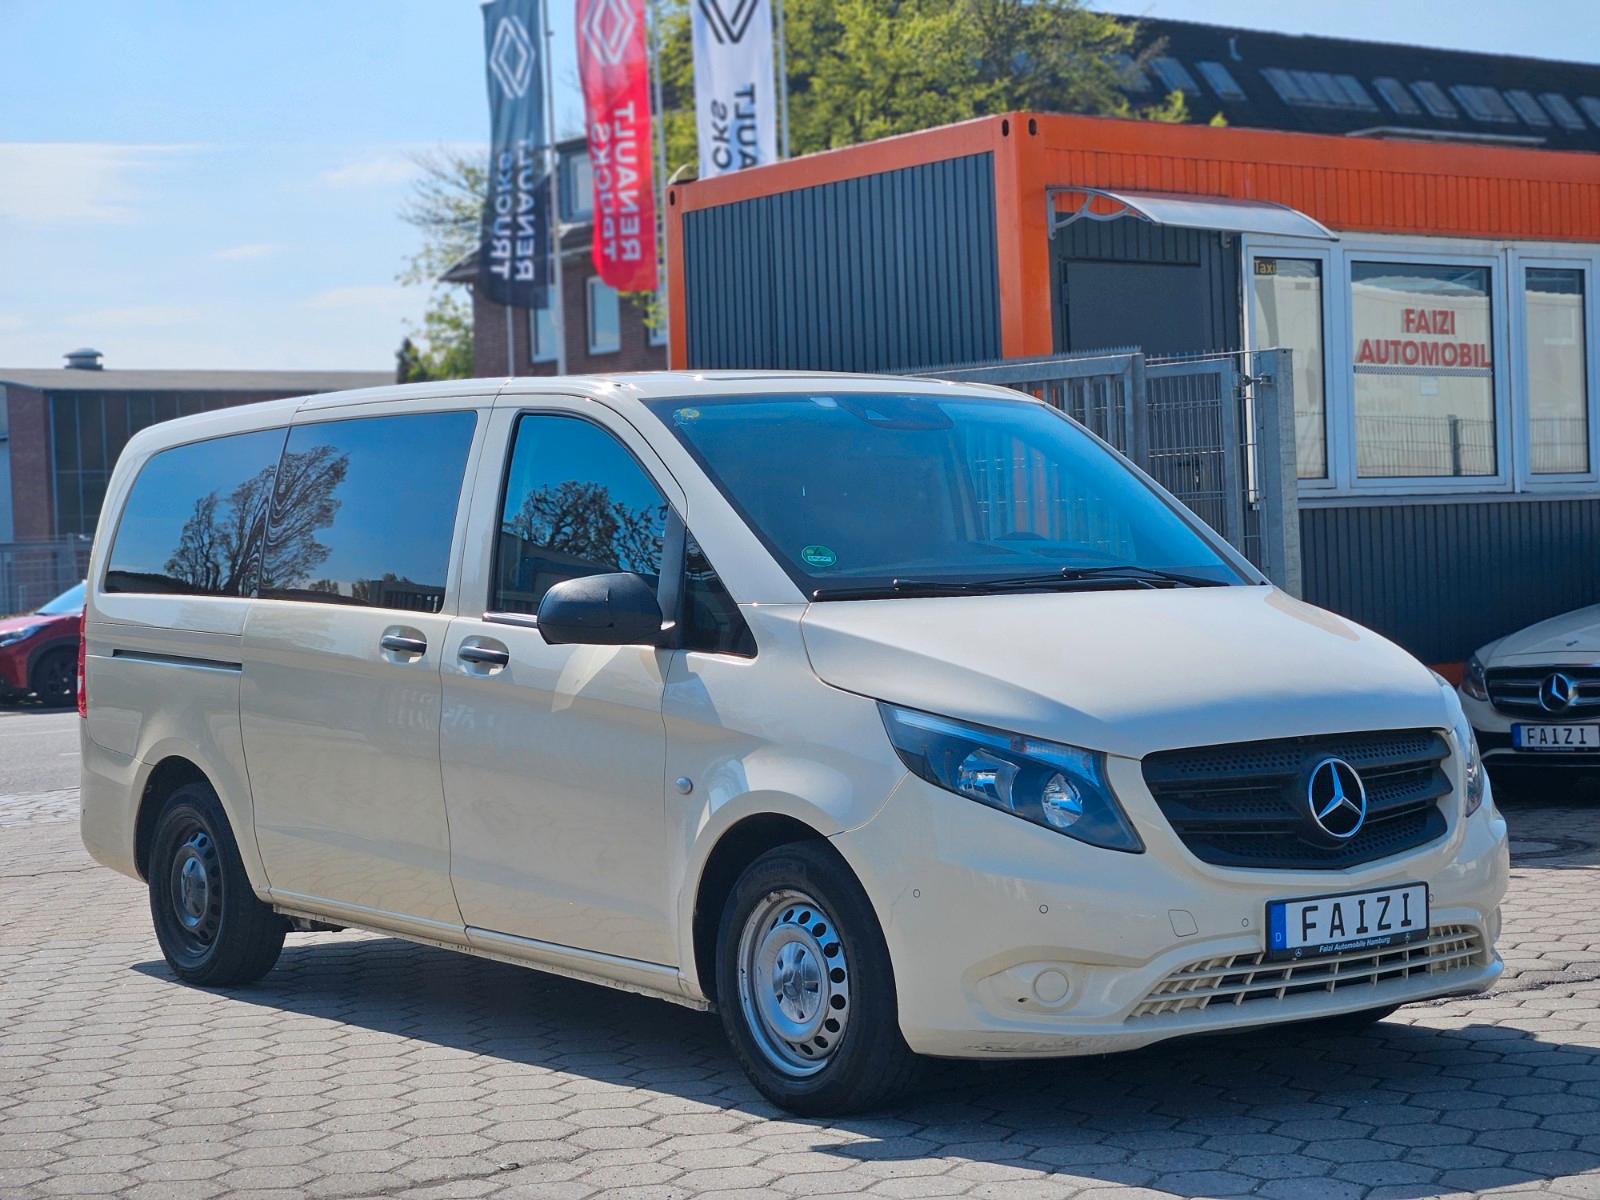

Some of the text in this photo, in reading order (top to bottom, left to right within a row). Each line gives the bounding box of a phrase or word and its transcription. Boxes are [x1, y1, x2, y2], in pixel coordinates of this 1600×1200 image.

[1255, 260, 1276, 274] Taxi
[1402, 308, 1456, 335] FAIZI
[1356, 338, 1492, 368] AUTOMOBIL
[1527, 727, 1587, 745] FAIZI
[1302, 893, 1412, 942] FAIZI
[1275, 932, 1282, 942] D
